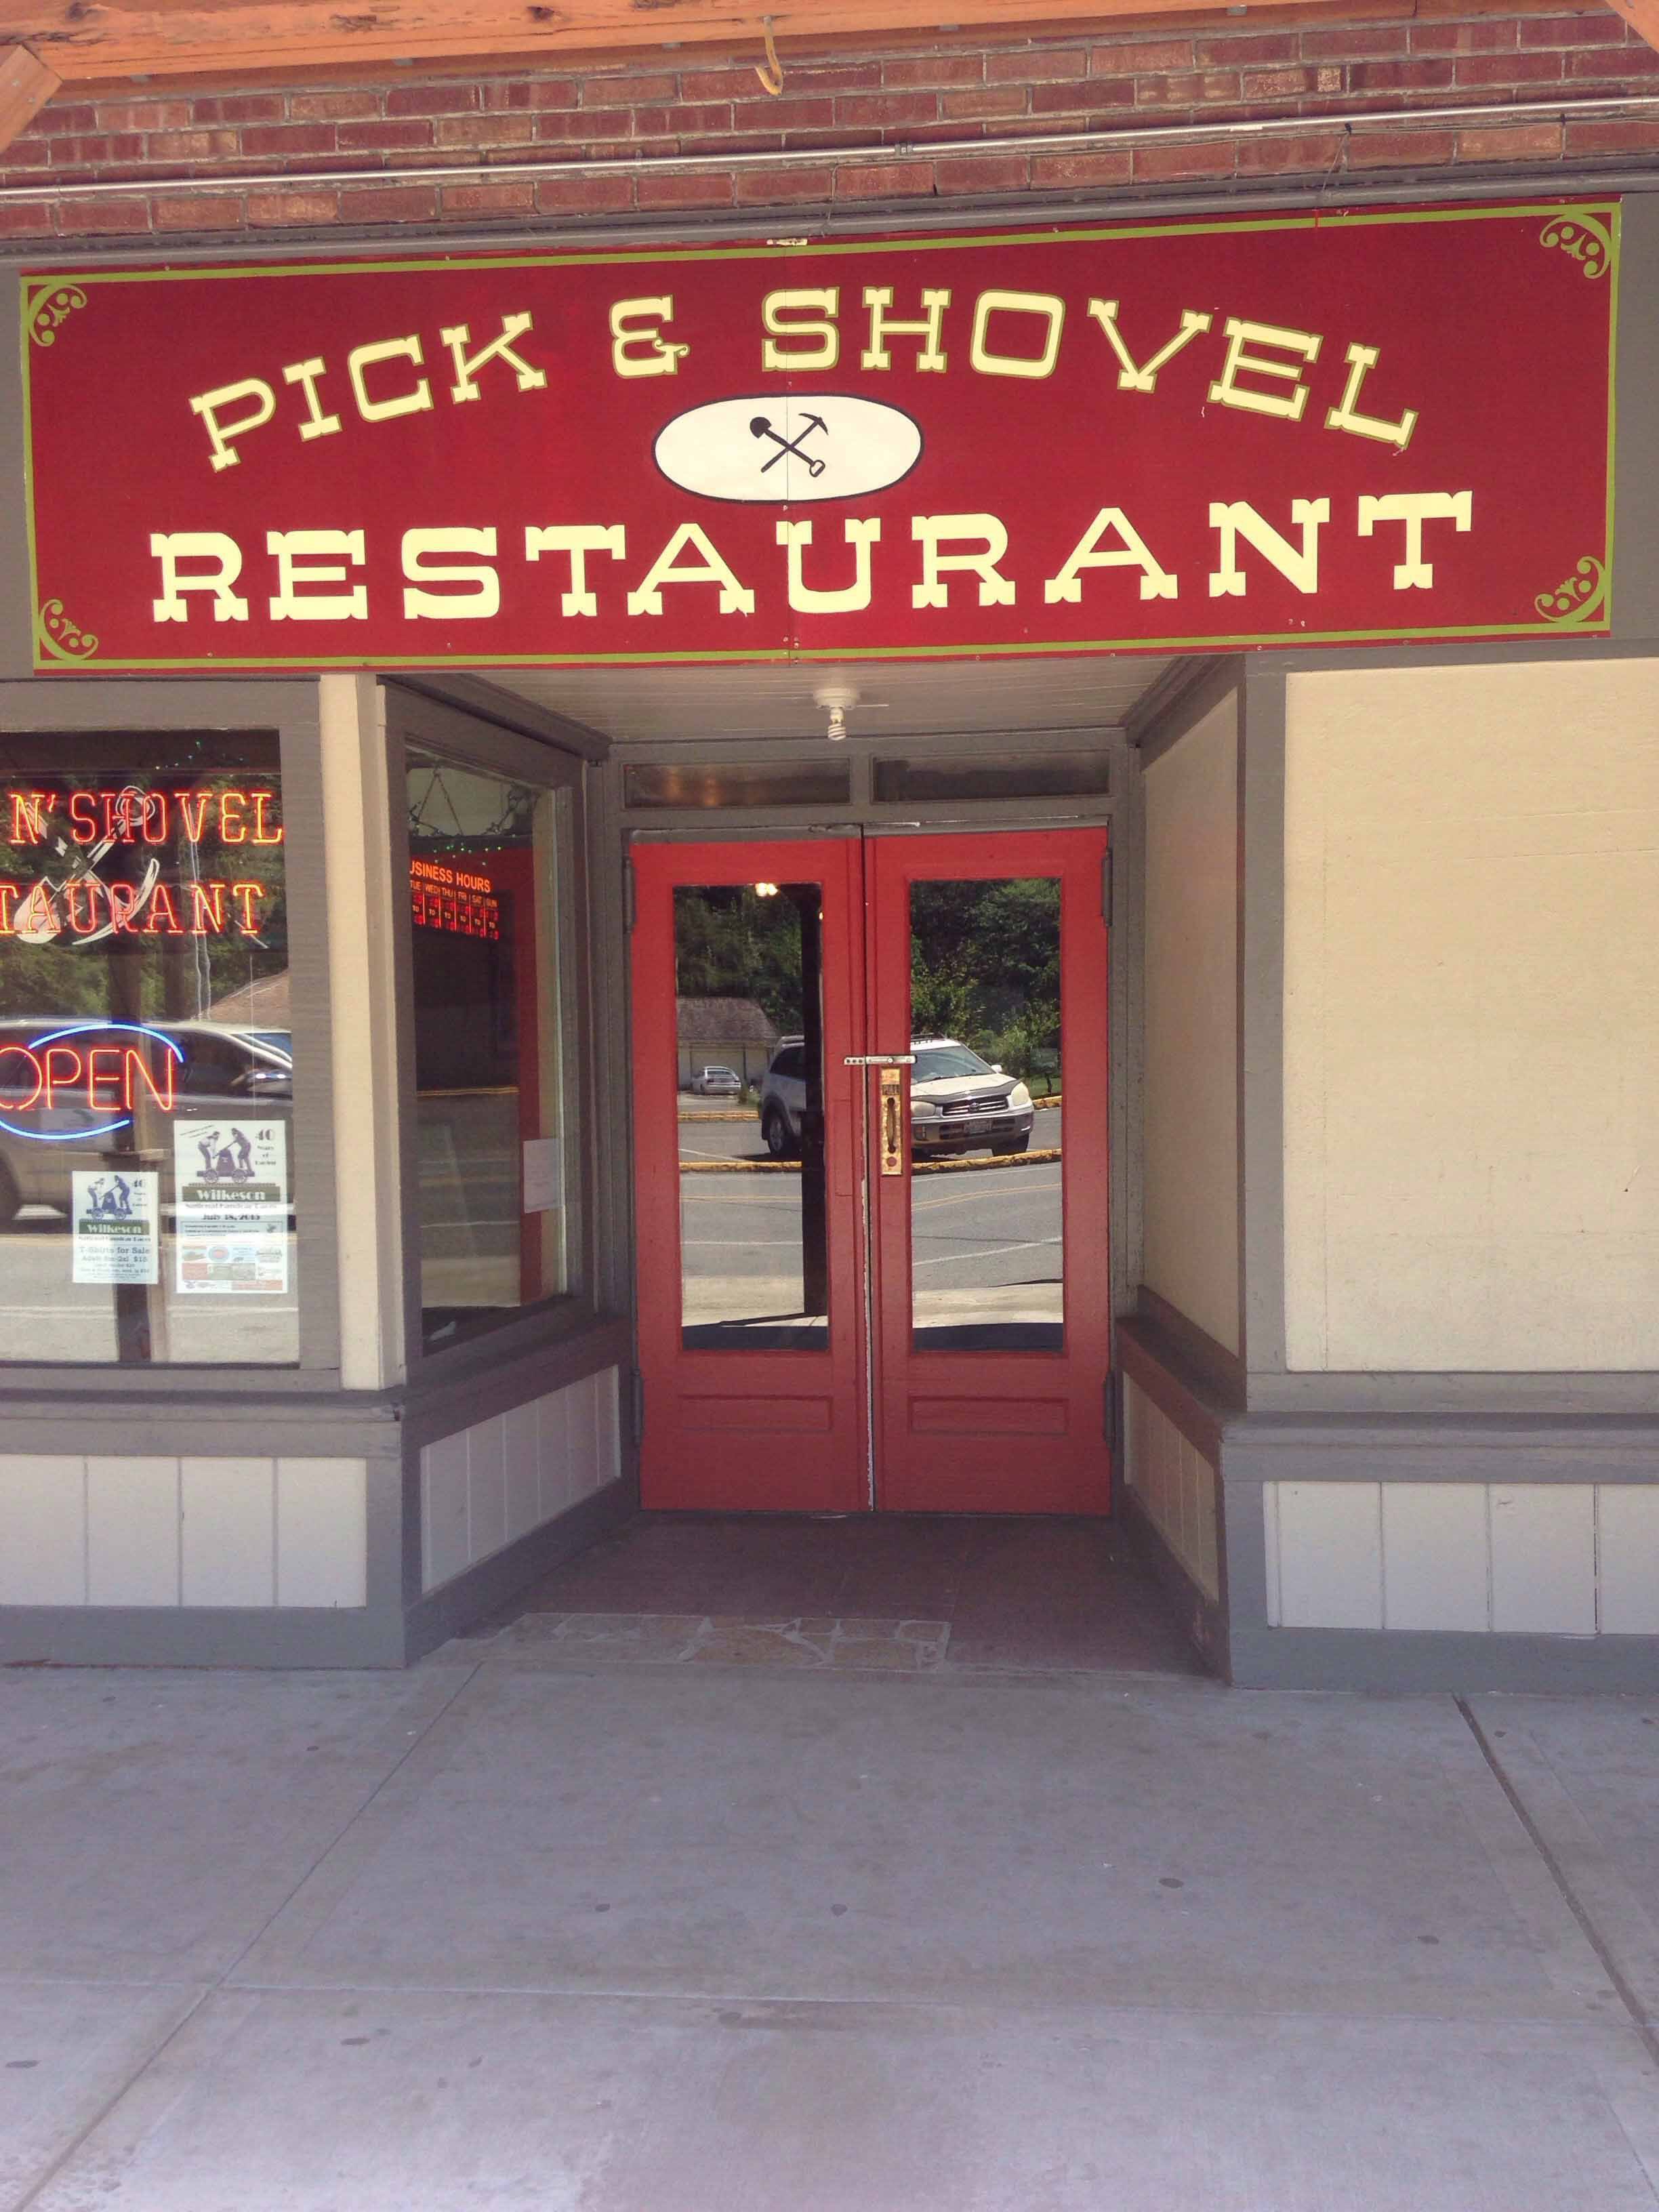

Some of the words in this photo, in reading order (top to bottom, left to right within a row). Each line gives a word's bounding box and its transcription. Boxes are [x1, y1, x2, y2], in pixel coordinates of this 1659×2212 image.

[188, 310, 548, 472] PICK
[609, 293, 691, 380] &
[761, 287, 1420, 449] SHOVEL
[150, 491, 1473, 622] RESTAURANT
[456, 872, 491, 893] HOURS
[0, 1046, 173, 1110] OPEN
[196, 1189, 266, 1200] Wilkeson
[87, 1223, 142, 1233] Wilkeson
